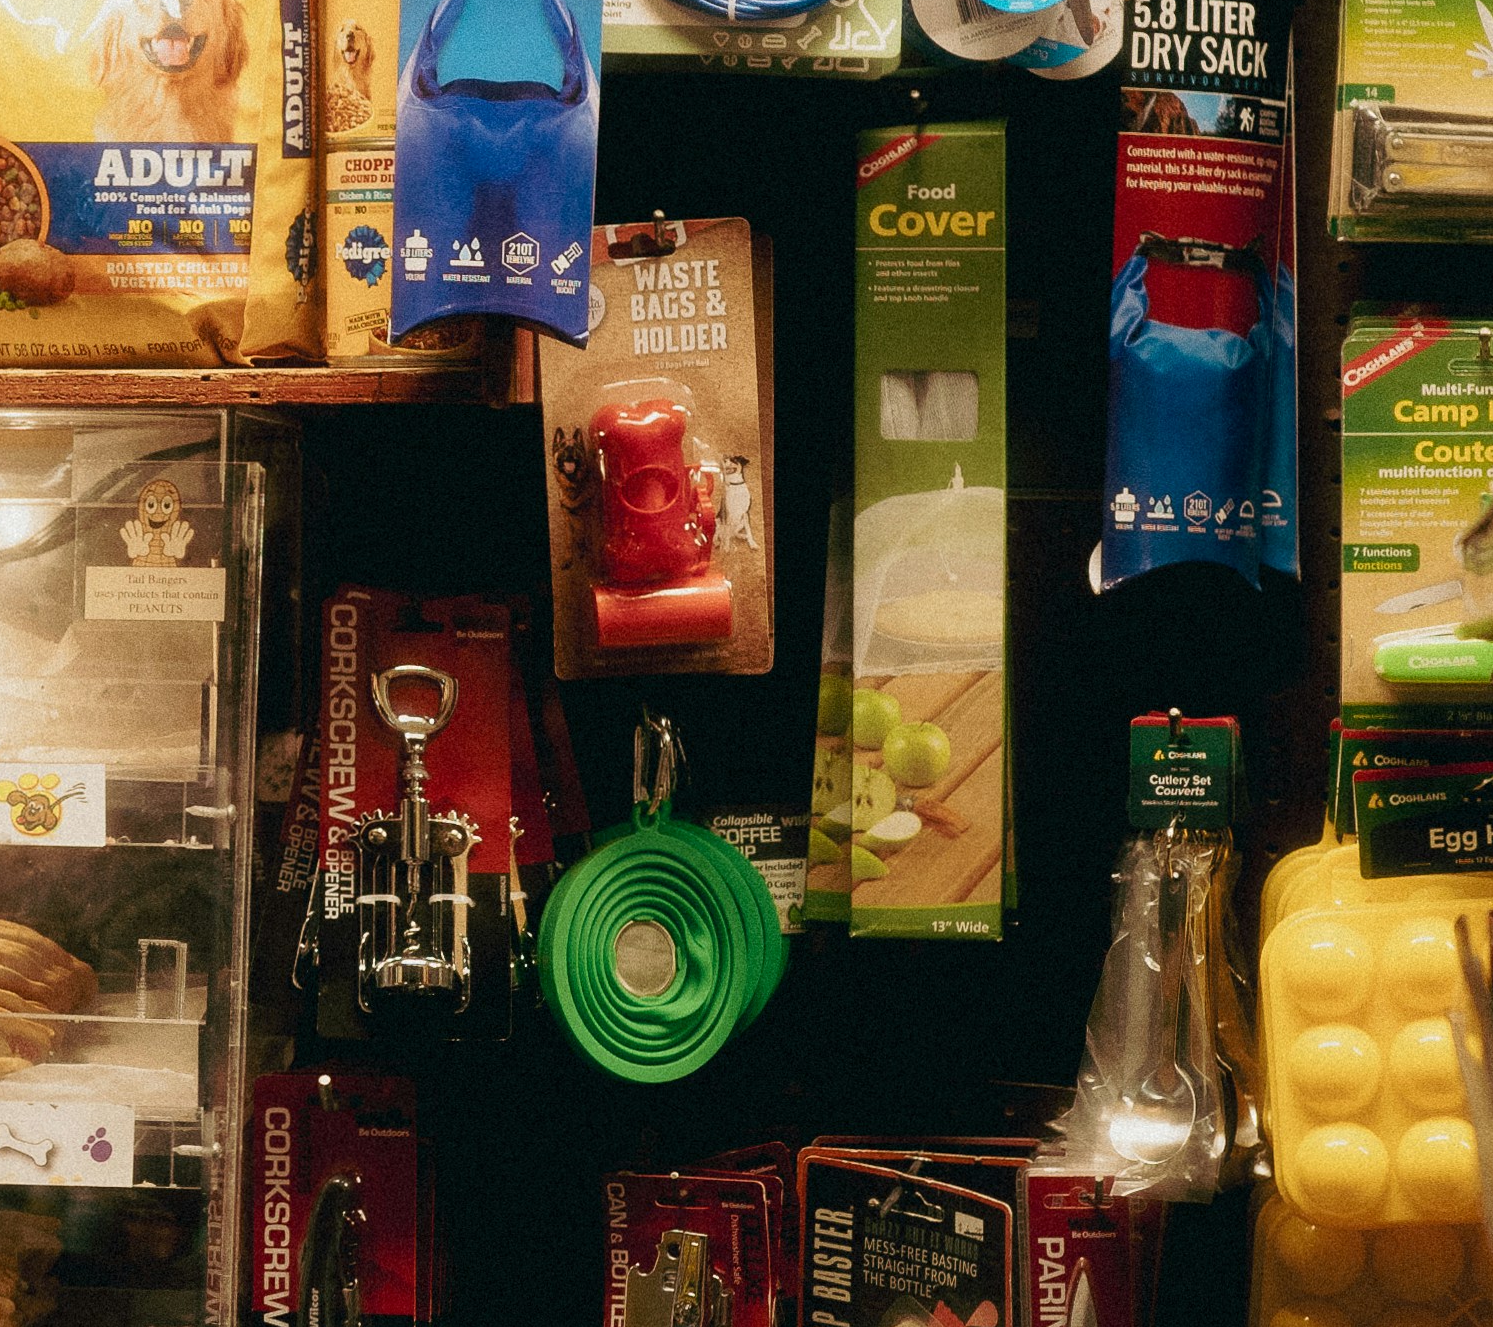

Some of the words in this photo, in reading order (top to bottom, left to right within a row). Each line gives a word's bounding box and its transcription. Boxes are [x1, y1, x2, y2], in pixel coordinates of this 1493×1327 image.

[1131, 31, 1193, 71] DRY
[1200, 36, 1270, 79] SACK
[283, 22, 304, 151] ADULT
[94, 148, 253, 187] ADULT
[340, 173, 377, 185] GROUND
[94, 191, 128, 204] 100%
[129, 191, 186, 205] Complete
[186, 191, 198, 204] &
[198, 191, 252, 204] Balanced
[906, 182, 957, 201] Food
[136, 203, 165, 215] Food
[166, 203, 187, 215] for
[188, 203, 222, 216] Adult
[223, 203, 253, 217] Dogs
[868, 203, 997, 239] Cover
[507, 242, 535, 257] 210T
[106, 261, 173, 277] ROASTED
[176, 261, 238, 277] CHICKEN
[633, 259, 721, 292] WASTE
[630, 292, 698, 323] BAGS
[705, 289, 728, 317] &
[632, 323, 728, 355] HOLDER
[1393, 399, 1480, 429] Camp
[1378, 465, 1478, 481] multifonction
[1352, 546, 1361, 558] 7
[1362, 546, 1413, 558] functions
[1352, 560, 1404, 571] fonctions
[128, 603, 184, 614] PEANUTS
[328, 603, 359, 824] CORKSCREW
[1148, 773, 1190, 790] Cutlery
[1192, 774, 1213, 788] Set
[1154, 785, 1206, 799] Couverts
[712, 813, 774, 828] Collapsible
[326, 825, 350, 846] &
[324, 848, 340, 921] OPENER
[339, 849, 355, 915] BOTTLE
[864, 1236, 930, 1264] MESS-FREE
[930, 1251, 979, 1278] BASTING
